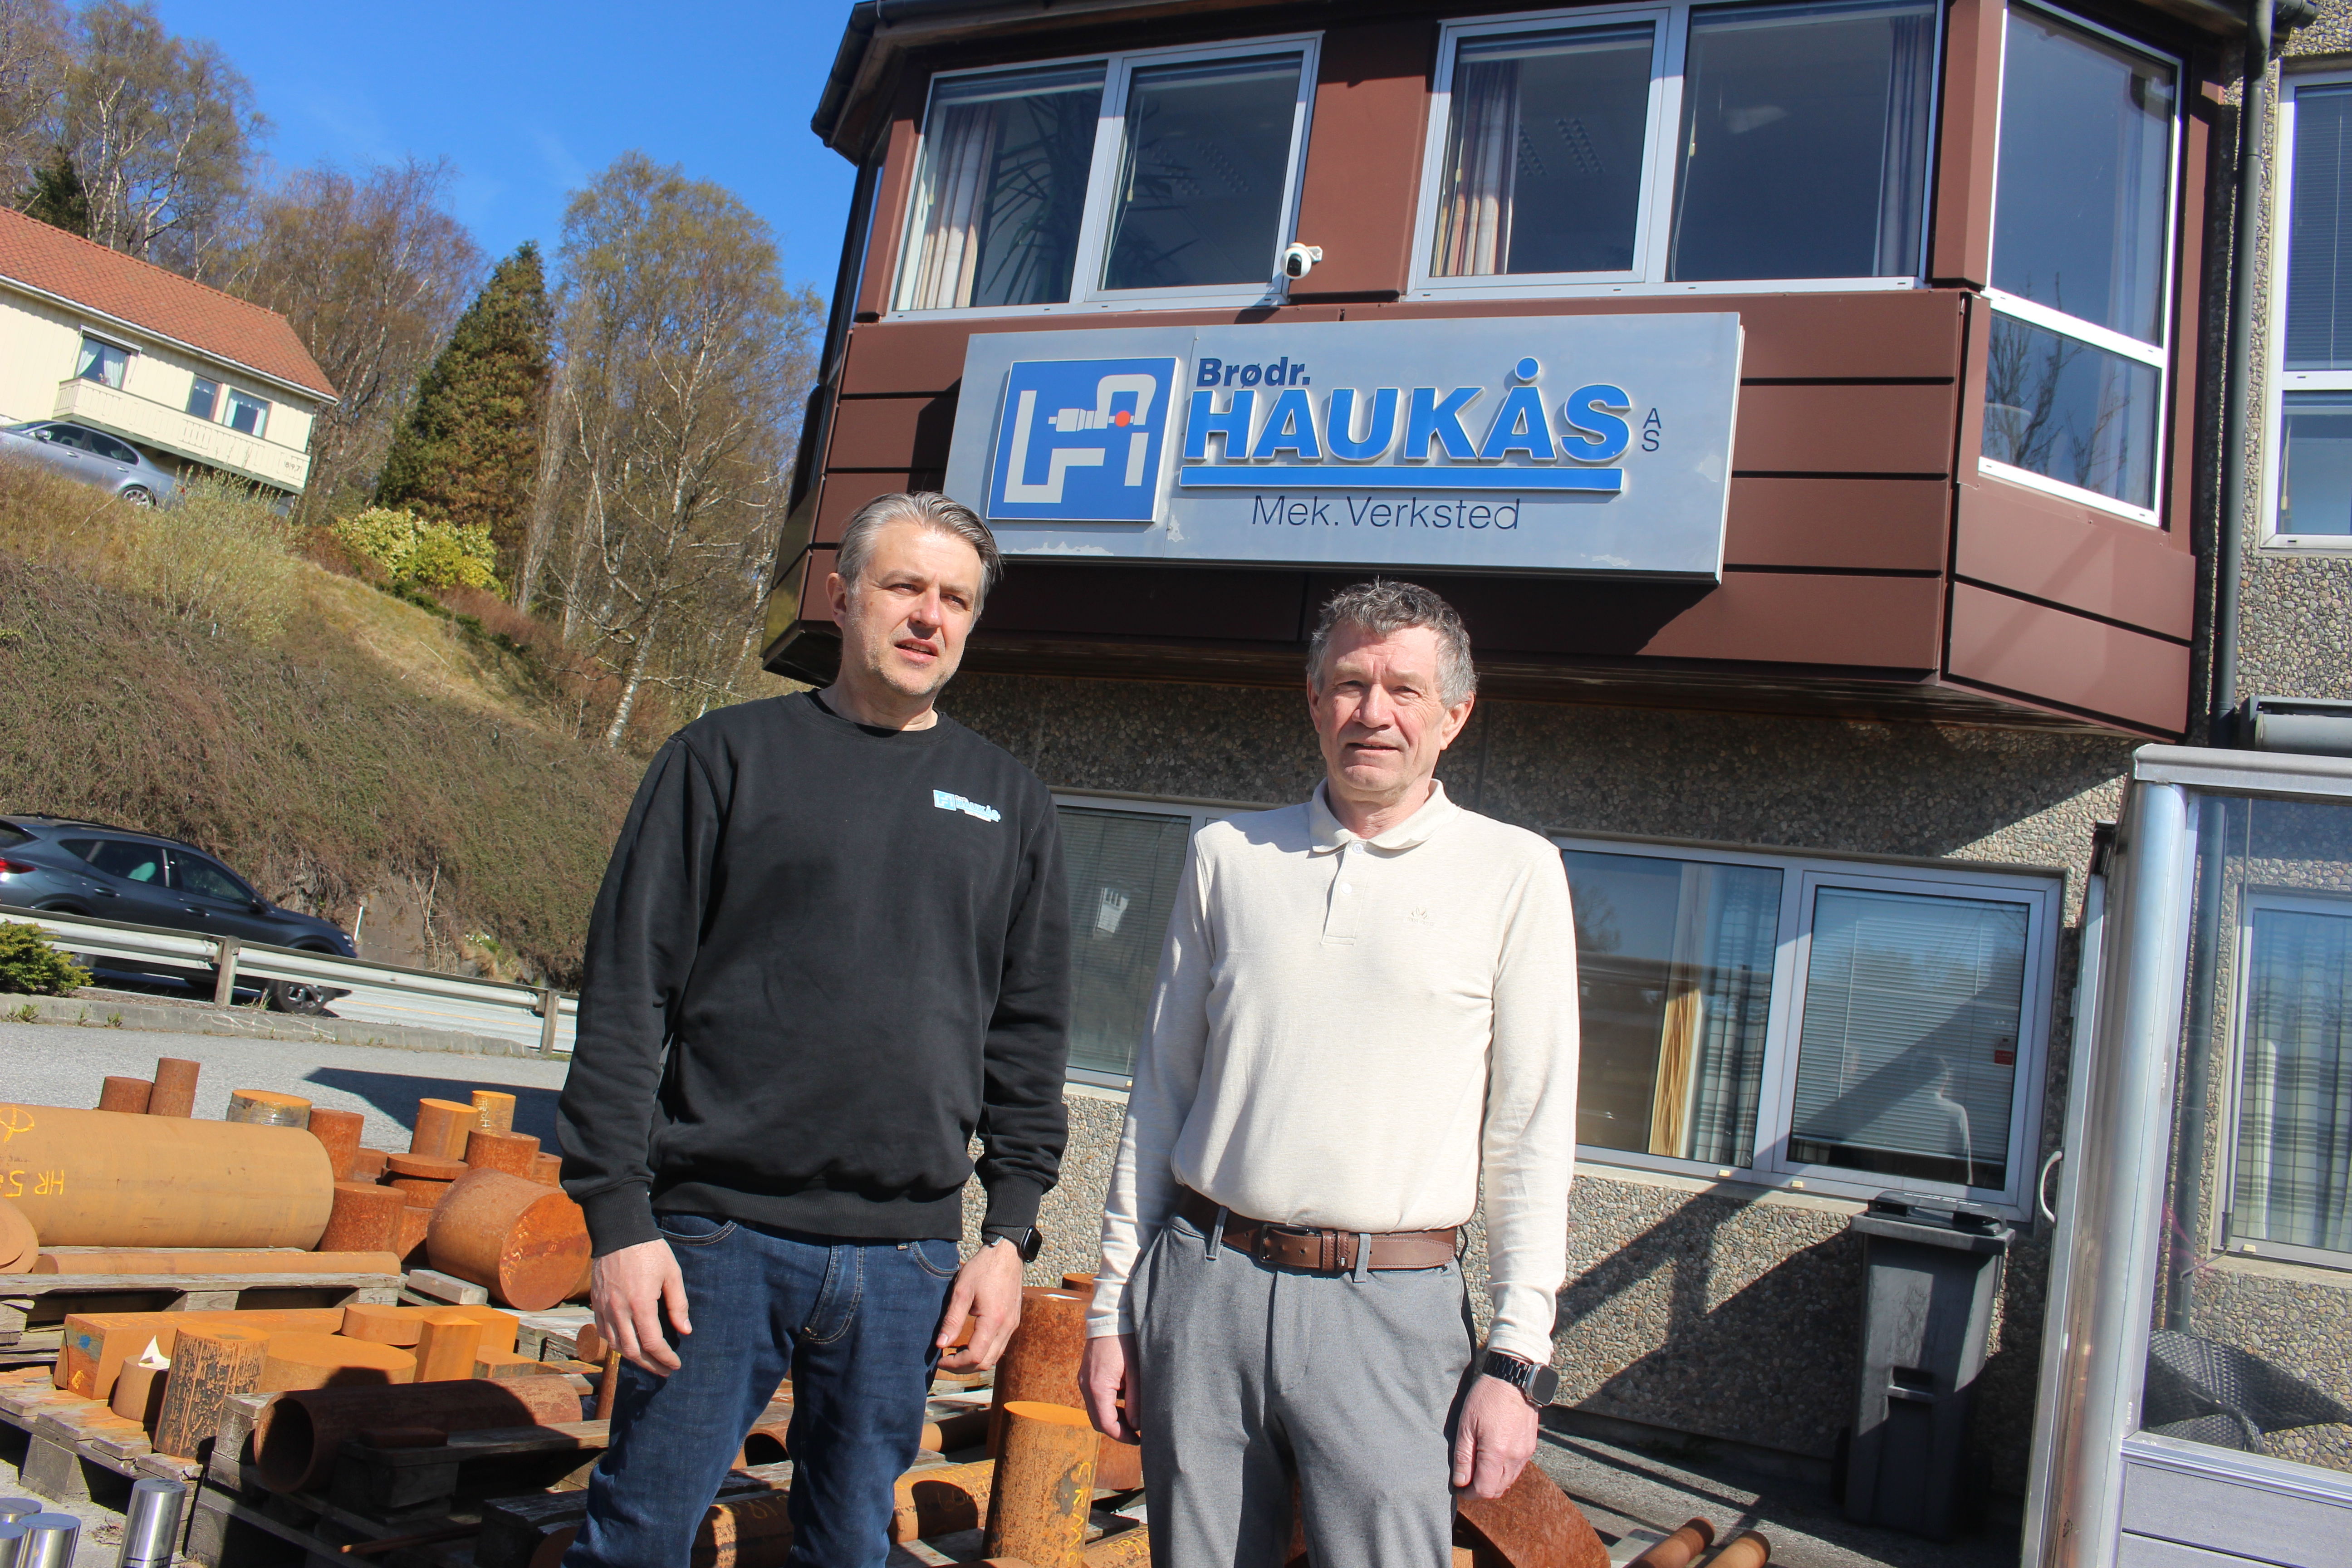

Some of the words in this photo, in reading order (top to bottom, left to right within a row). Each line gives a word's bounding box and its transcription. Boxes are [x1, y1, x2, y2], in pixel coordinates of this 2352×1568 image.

[1196, 357, 1310, 388] Brødr.
[1183, 356, 1632, 462] HAUKÅS
[285, 461, 301, 471] 897
[1252, 495, 1338, 526] Mek.
[1347, 495, 1520, 529] Verksted
